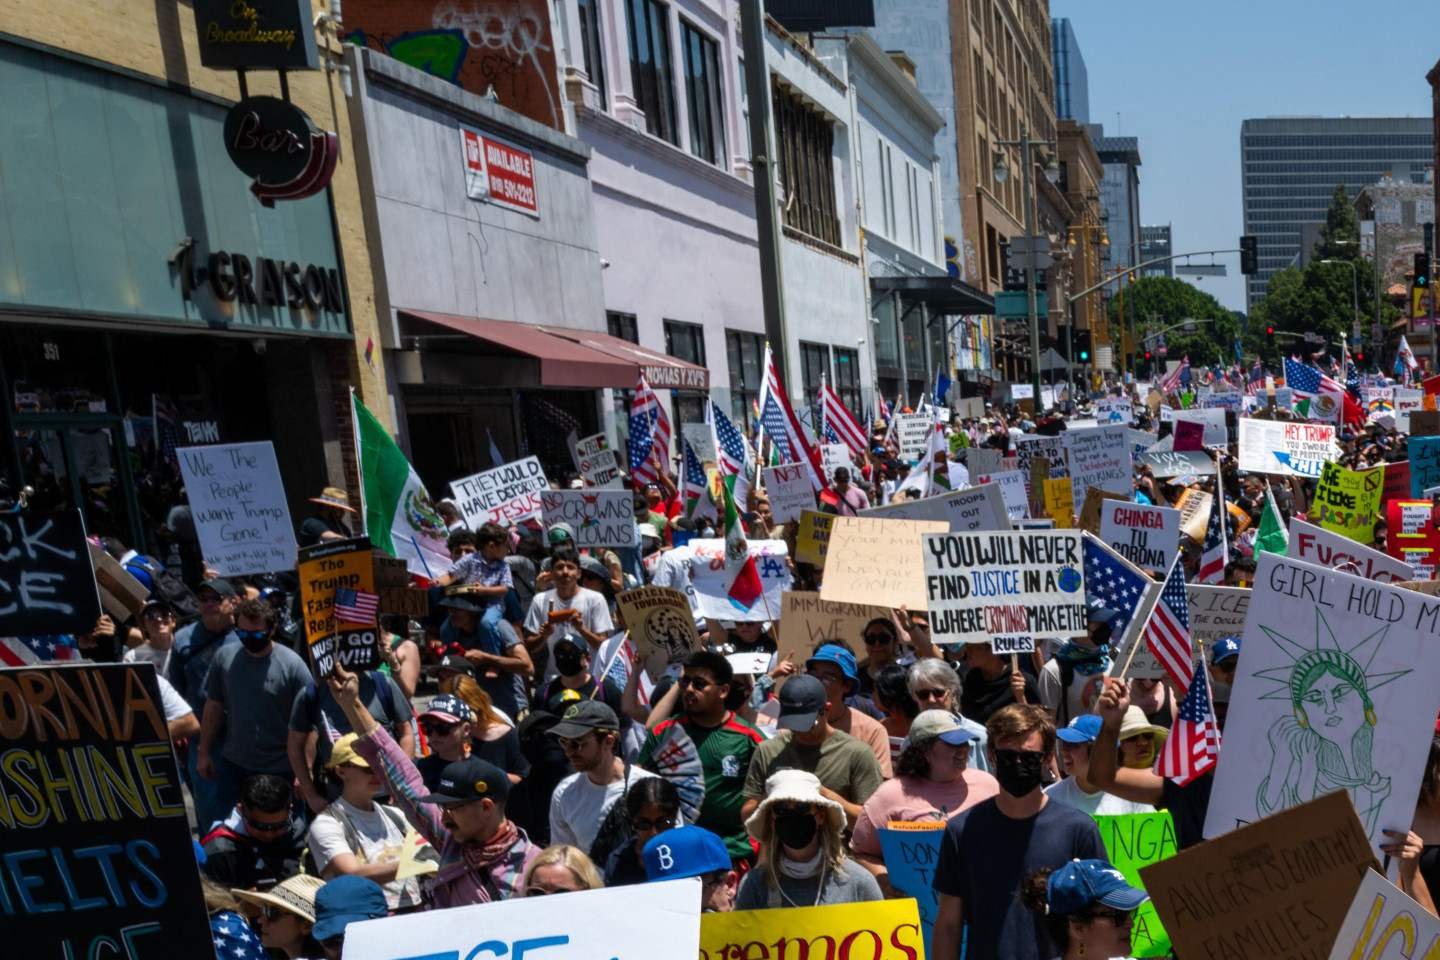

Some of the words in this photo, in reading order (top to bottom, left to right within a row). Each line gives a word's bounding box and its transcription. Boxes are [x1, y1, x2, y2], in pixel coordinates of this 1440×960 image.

[232, 110, 306, 154] Bar
[487, 143, 532, 179] AVAILABLE
[208, 250, 343, 314] GRAYSON
[646, 366, 681, 386] NOVIAS
[1284, 424, 1301, 441] HEY
[1304, 425, 1333, 443] TRUMP
[1286, 440, 1300, 450] YOU
[1302, 441, 1331, 451] SWORE
[184, 451, 217, 477] We
[224, 448, 259, 470] The
[1289, 458, 1325, 476] THIS
[1301, 450, 1333, 461] PROTECT
[209, 480, 255, 501] People
[455, 473, 498, 498] THEY
[497, 460, 540, 484] WOULD
[462, 491, 498, 518] HAVE
[496, 476, 548, 503] DEPORTED
[487, 491, 542, 525] JESUS
[948, 493, 986, 508] TROOPS
[197, 508, 236, 524] want
[240, 500, 283, 521] Trump
[562, 497, 633, 522] CROWNS
[961, 508, 980, 519] OUT
[1113, 507, 1165, 530] CHINGA
[1130, 528, 1147, 547] TU
[928, 535, 975, 570] YOU
[974, 535, 1020, 566] WILL
[1019, 535, 1080, 565] NEVER
[319, 559, 346, 573] The
[309, 573, 361, 594] Trump
[928, 574, 971, 601] FIND
[970, 569, 1022, 598] JUSTICE
[1023, 569, 1041, 594] IN
[1044, 569, 1059, 594] A
[1269, 563, 1334, 609] GIRL
[1347, 582, 1405, 624] HOLD
[789, 598, 888, 618] IMMIGRANTS
[930, 607, 986, 635] WHERE
[984, 603, 1029, 635] CRIMINALS
[1025, 603, 1066, 633] MAKE
[1064, 603, 1088, 632] THE
[803, 618, 845, 642] WE
[311, 634, 343, 660] MUST
[347, 631, 376, 647] GO
[993, 636, 1034, 652] RULES
[1167, 870, 1256, 927] ANGER
